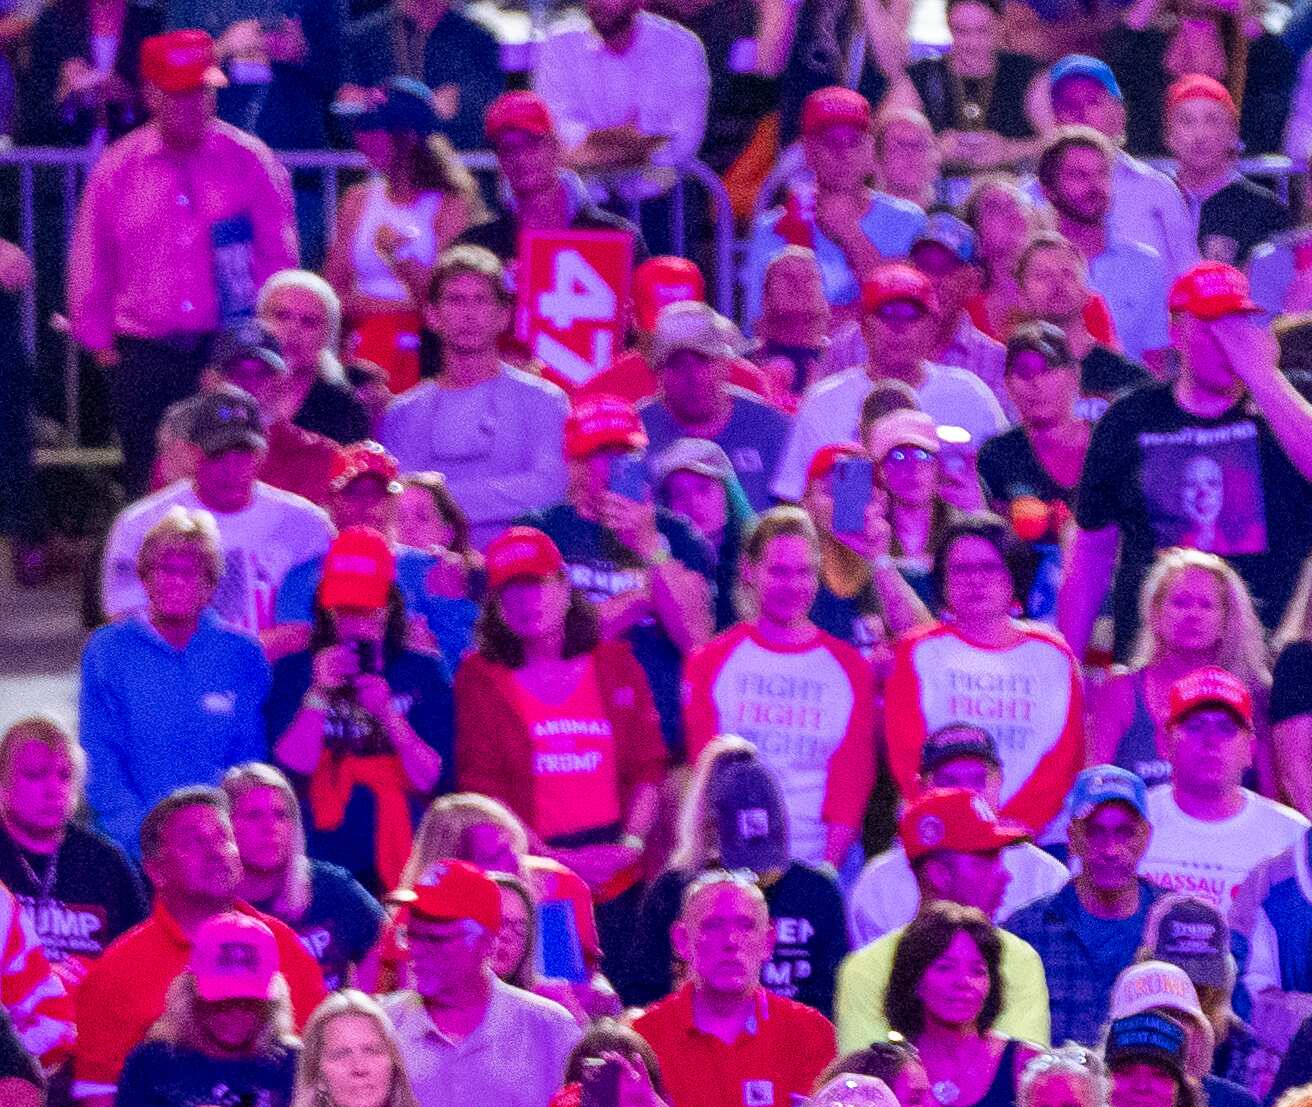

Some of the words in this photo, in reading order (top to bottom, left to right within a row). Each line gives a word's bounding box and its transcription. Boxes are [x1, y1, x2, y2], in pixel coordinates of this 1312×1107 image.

[535, 249, 617, 385] 47
[737, 674, 827, 701] FIGHT
[948, 671, 1036, 698] FIGHT
[736, 701, 826, 729] FIGHT
[948, 696, 1036, 722] FIGHT
